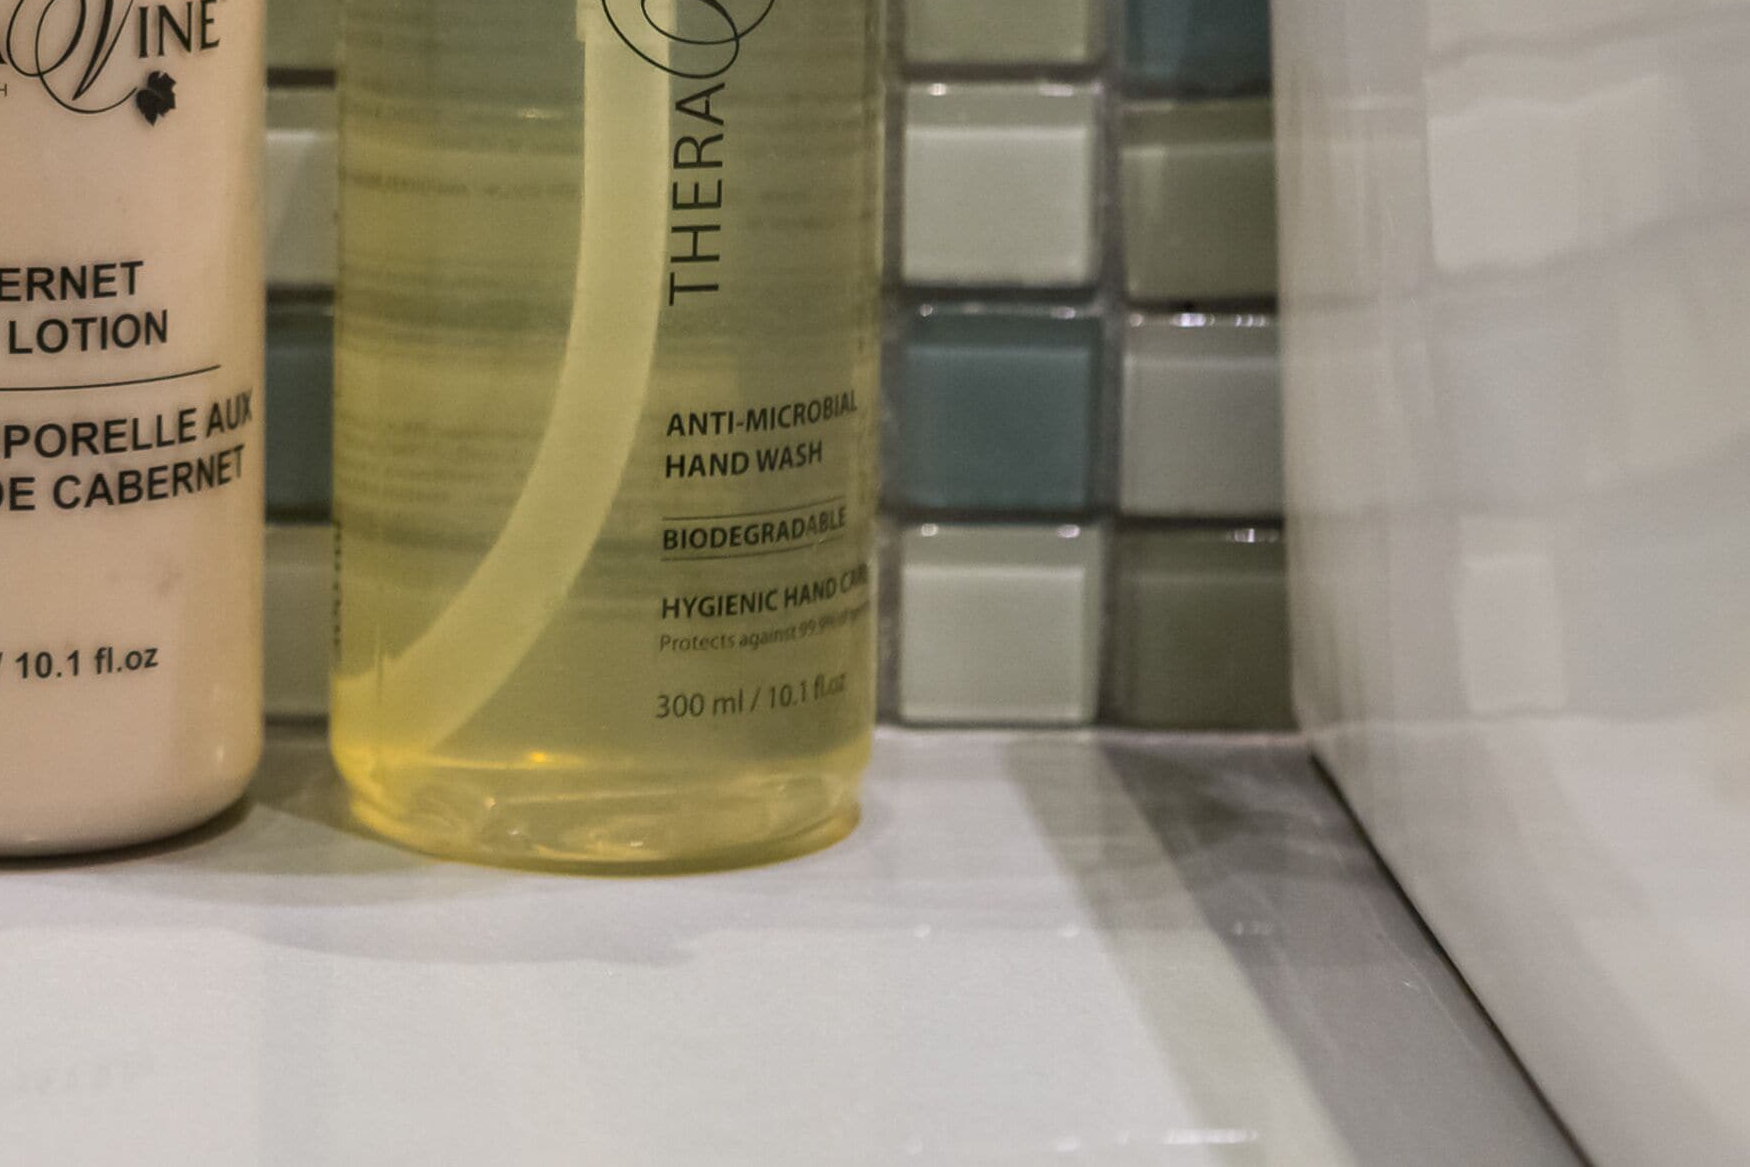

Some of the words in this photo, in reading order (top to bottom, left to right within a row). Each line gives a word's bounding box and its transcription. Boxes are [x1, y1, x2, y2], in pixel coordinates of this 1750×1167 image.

[8, 309, 168, 354] LOTION
[205, 387, 254, 439] AUX
[666, 389, 858, 437] ANTI-MICROBIAL
[52, 443, 246, 511] CABERNET
[665, 451, 749, 479] HAND
[756, 439, 823, 473] WASH
[662, 506, 848, 551] BIODEGRADABLE
[661, 589, 778, 621] HYGIENIC
[783, 577, 837, 609] HAND
[15, 649, 81, 679] 10.1
[95, 645, 159, 675] fl.oz
[659, 633, 736, 653] Protects
[655, 692, 706, 720] 300
[712, 687, 744, 717] ml
[769, 680, 808, 710] 10.1
